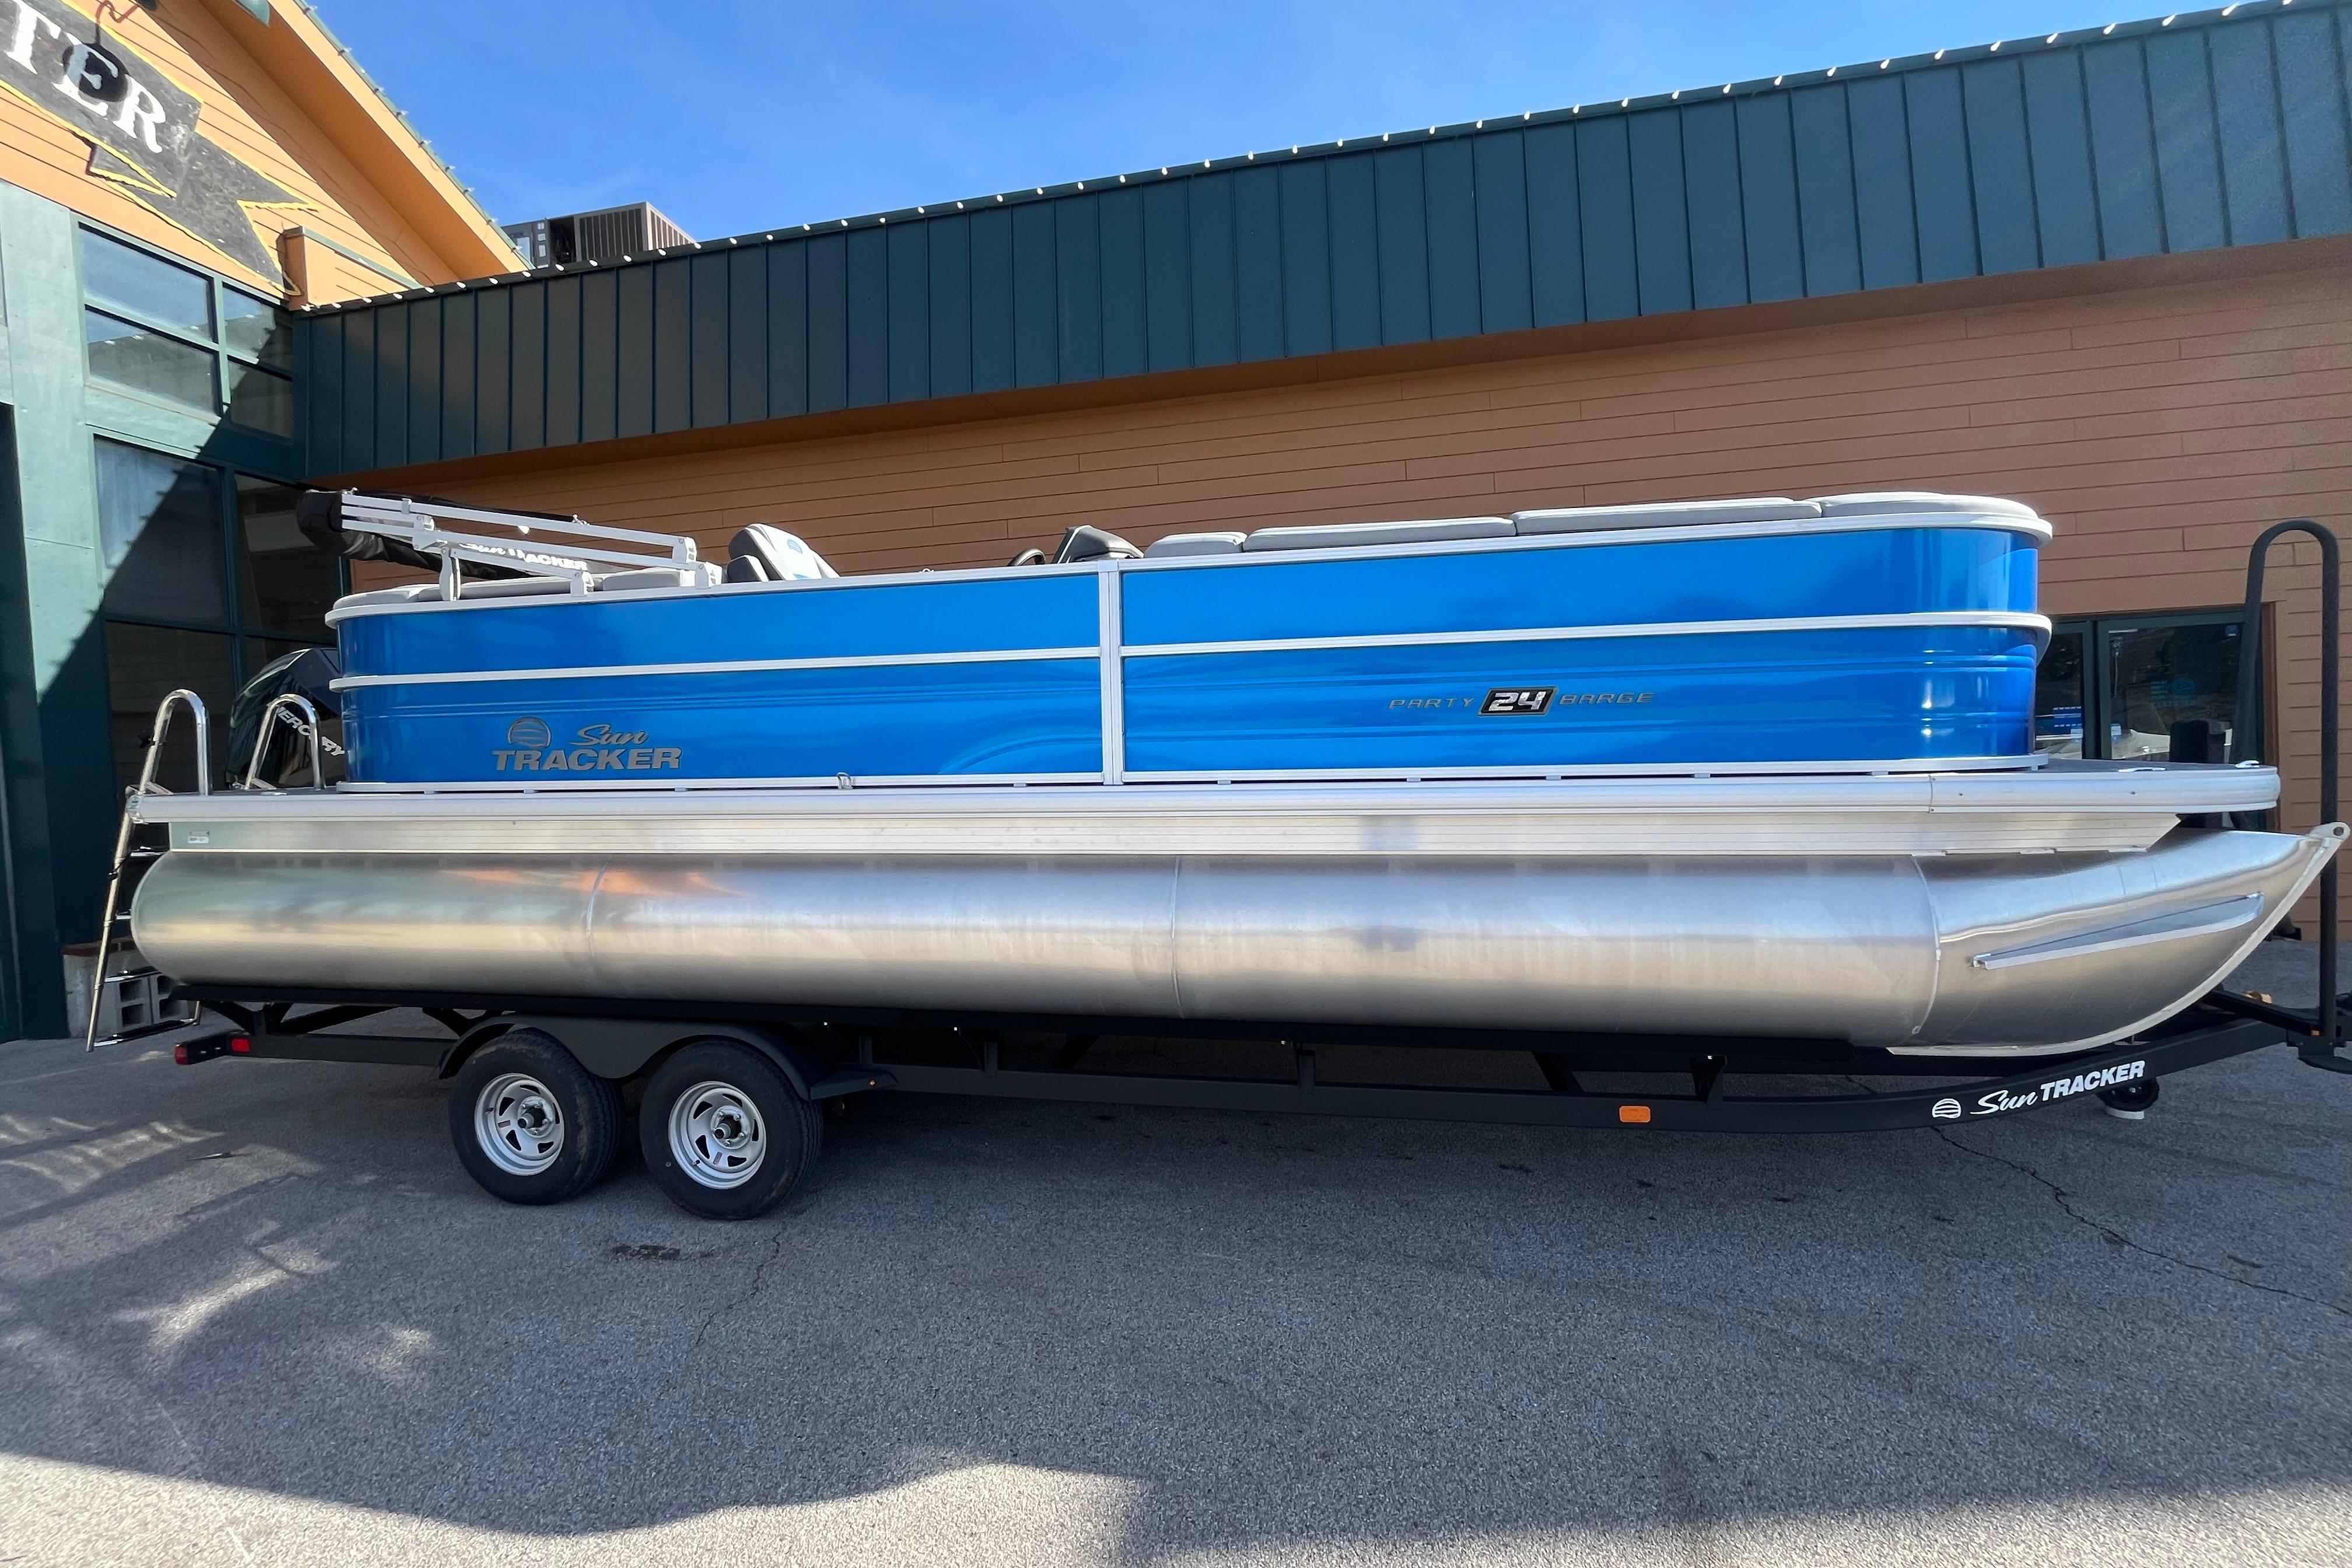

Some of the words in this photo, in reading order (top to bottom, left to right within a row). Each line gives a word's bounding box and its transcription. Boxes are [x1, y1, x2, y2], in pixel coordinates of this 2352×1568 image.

[1388, 697, 1475, 710] PARTY
[1488, 691, 1547, 712] 24
[1559, 692, 1656, 706] BARGE
[275, 706, 345, 756] ERCRY
[569, 723, 649, 746] Sun
[492, 747, 683, 771] TRACKER
[1969, 1090, 2039, 1115] Sun
[2041, 1060, 2146, 1101] TRACKER
